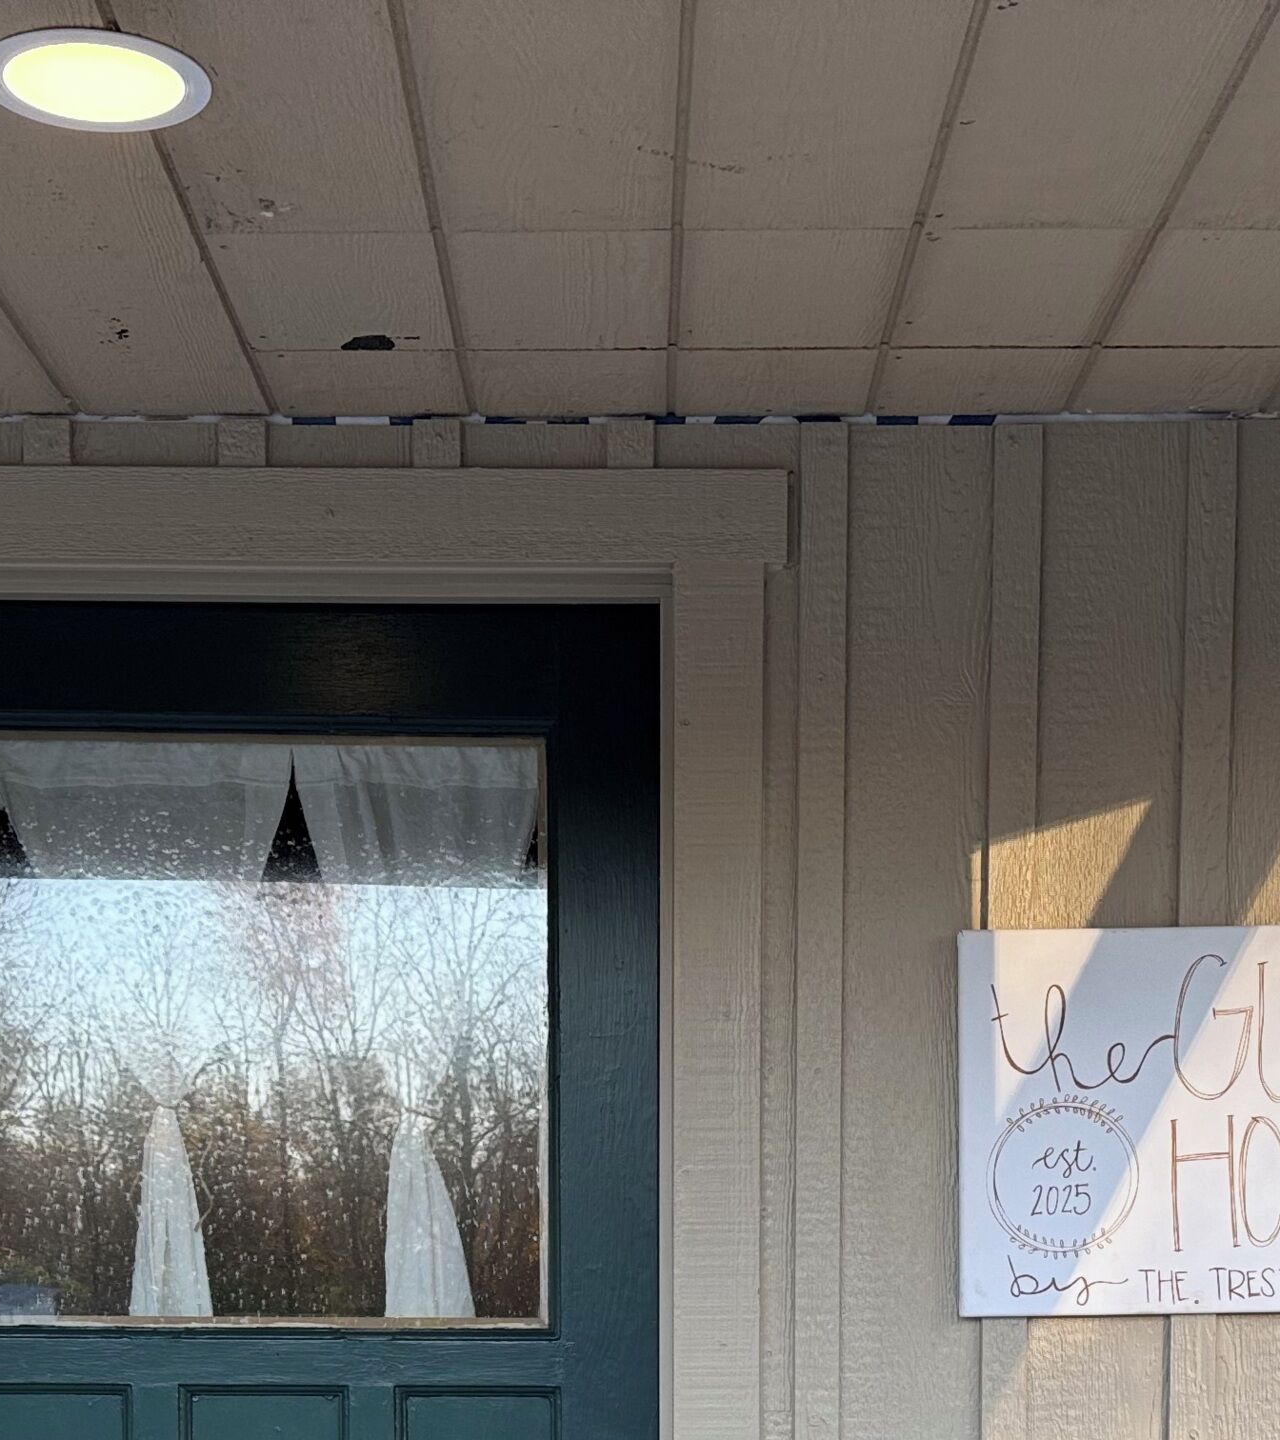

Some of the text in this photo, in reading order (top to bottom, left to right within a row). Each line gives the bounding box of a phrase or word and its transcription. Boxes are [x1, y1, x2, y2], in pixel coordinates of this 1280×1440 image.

[991, 983, 1176, 1092] the
[1030, 1139, 1097, 1179] est.
[1030, 1182, 1092, 1217] 2025
[1007, 1255, 1129, 1306] by
